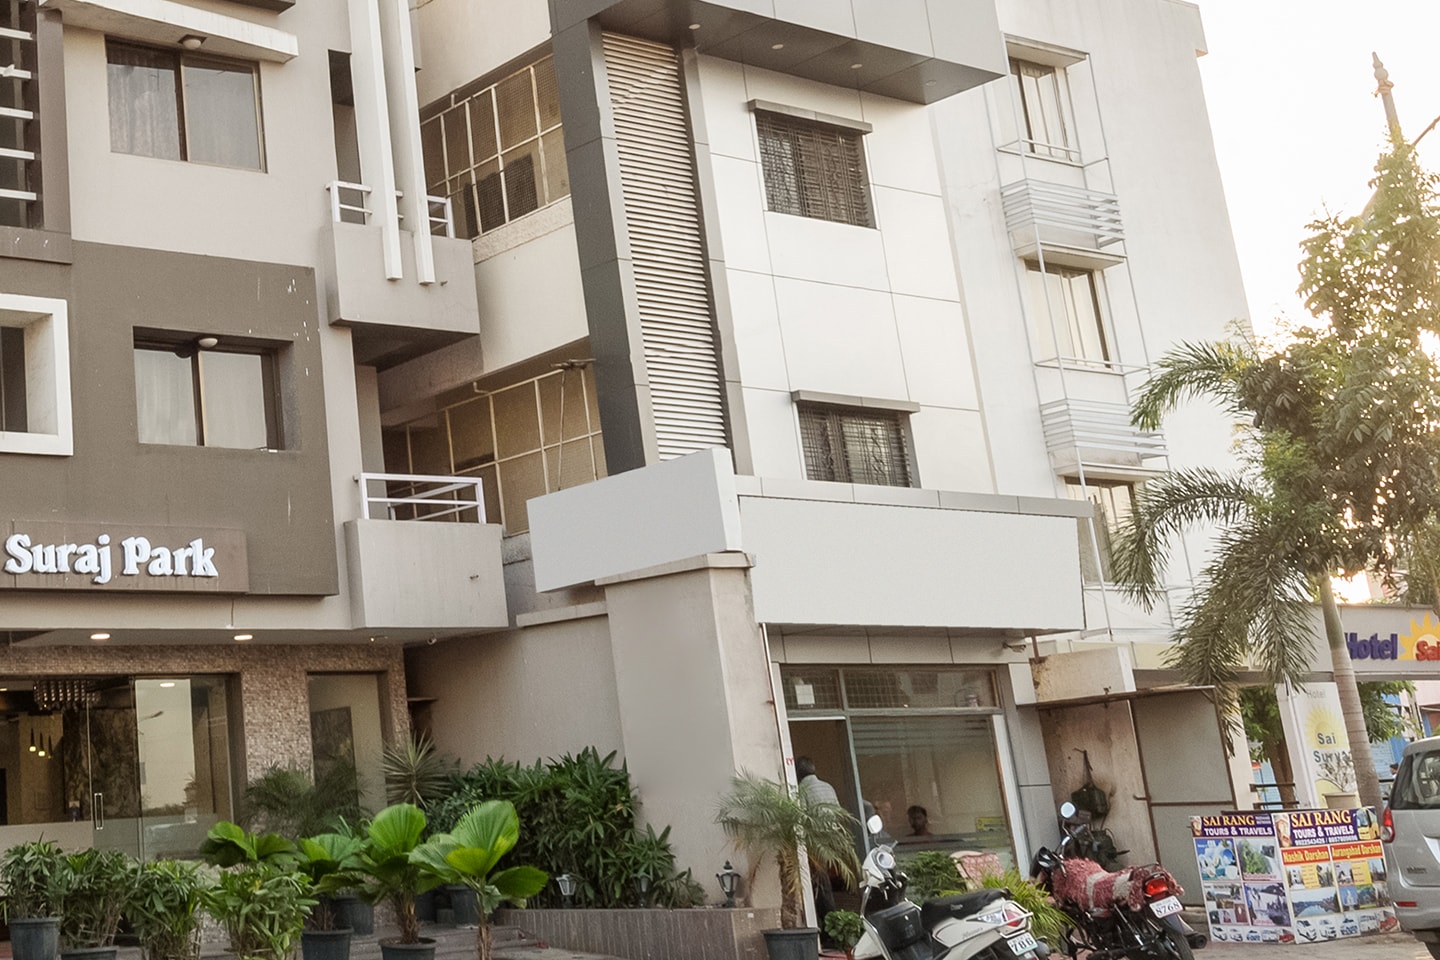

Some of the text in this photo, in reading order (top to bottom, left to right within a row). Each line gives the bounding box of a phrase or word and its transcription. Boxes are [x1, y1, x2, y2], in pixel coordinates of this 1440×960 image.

[4, 533, 113, 585] Suraj
[121, 535, 220, 578] Park
[1345, 632, 1398, 660] Hotel
[1317, 732, 1336, 745] Sai
[1203, 816, 1221, 826] SAI
[1222, 814, 1255, 826] RANG
[1290, 812, 1314, 828] SAI
[1314, 809, 1352, 826] RANG
[1204, 826, 1273, 836] TOURS & TRAVELS
[1293, 824, 1354, 839] TOURS & TRAVELS
